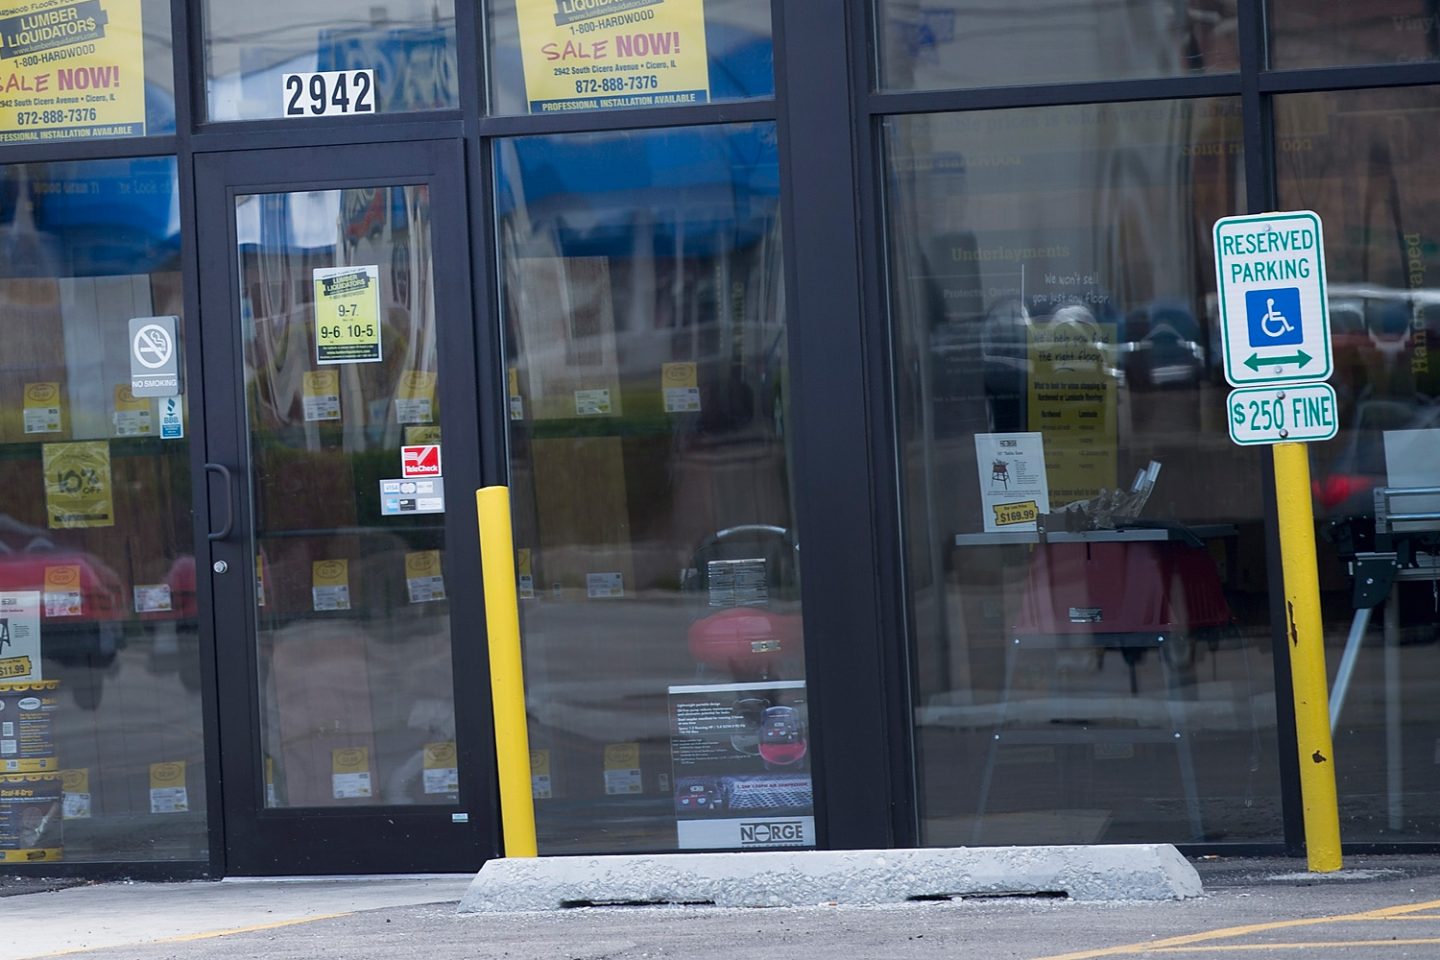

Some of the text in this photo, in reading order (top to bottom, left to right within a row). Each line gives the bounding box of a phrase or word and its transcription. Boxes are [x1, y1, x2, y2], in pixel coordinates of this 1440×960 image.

[20, 7, 78, 30] LUMBER
[570, 9, 655, 35] 1-800-HARDWOOD
[8, 16, 96, 47] LIQUIDATOR$
[14, 43, 96, 68] 1-800-HARDWOOD
[541, 32, 680, 61] SALE NOW!
[58, 66, 120, 91] NOW!
[571, 65, 591, 75] South
[592, 64, 613, 74] Cicero
[615, 63, 639, 72] Avenue
[286, 71, 371, 115] 2942
[575, 75, 658, 93] 872-888-7376
[14, 98, 32, 107] South
[33, 97, 55, 106] Cicero
[56, 96, 79, 105] Avenue
[542, 93, 696, 111] PROFESSIONAL INSTALLATION AVAILABLE
[17, 108, 96, 125] 872-888-7376
[40, 128, 90, 140] INSTALLATION
[92, 126, 132, 136] AVAILABLE
[1223, 229, 1313, 255] RESERVED
[1231, 258, 1310, 283] PARKING
[144, 379, 177, 387] SMOKING
[1233, 396, 1332, 431] $250 FINE
[740, 823, 803, 840] NORGE
